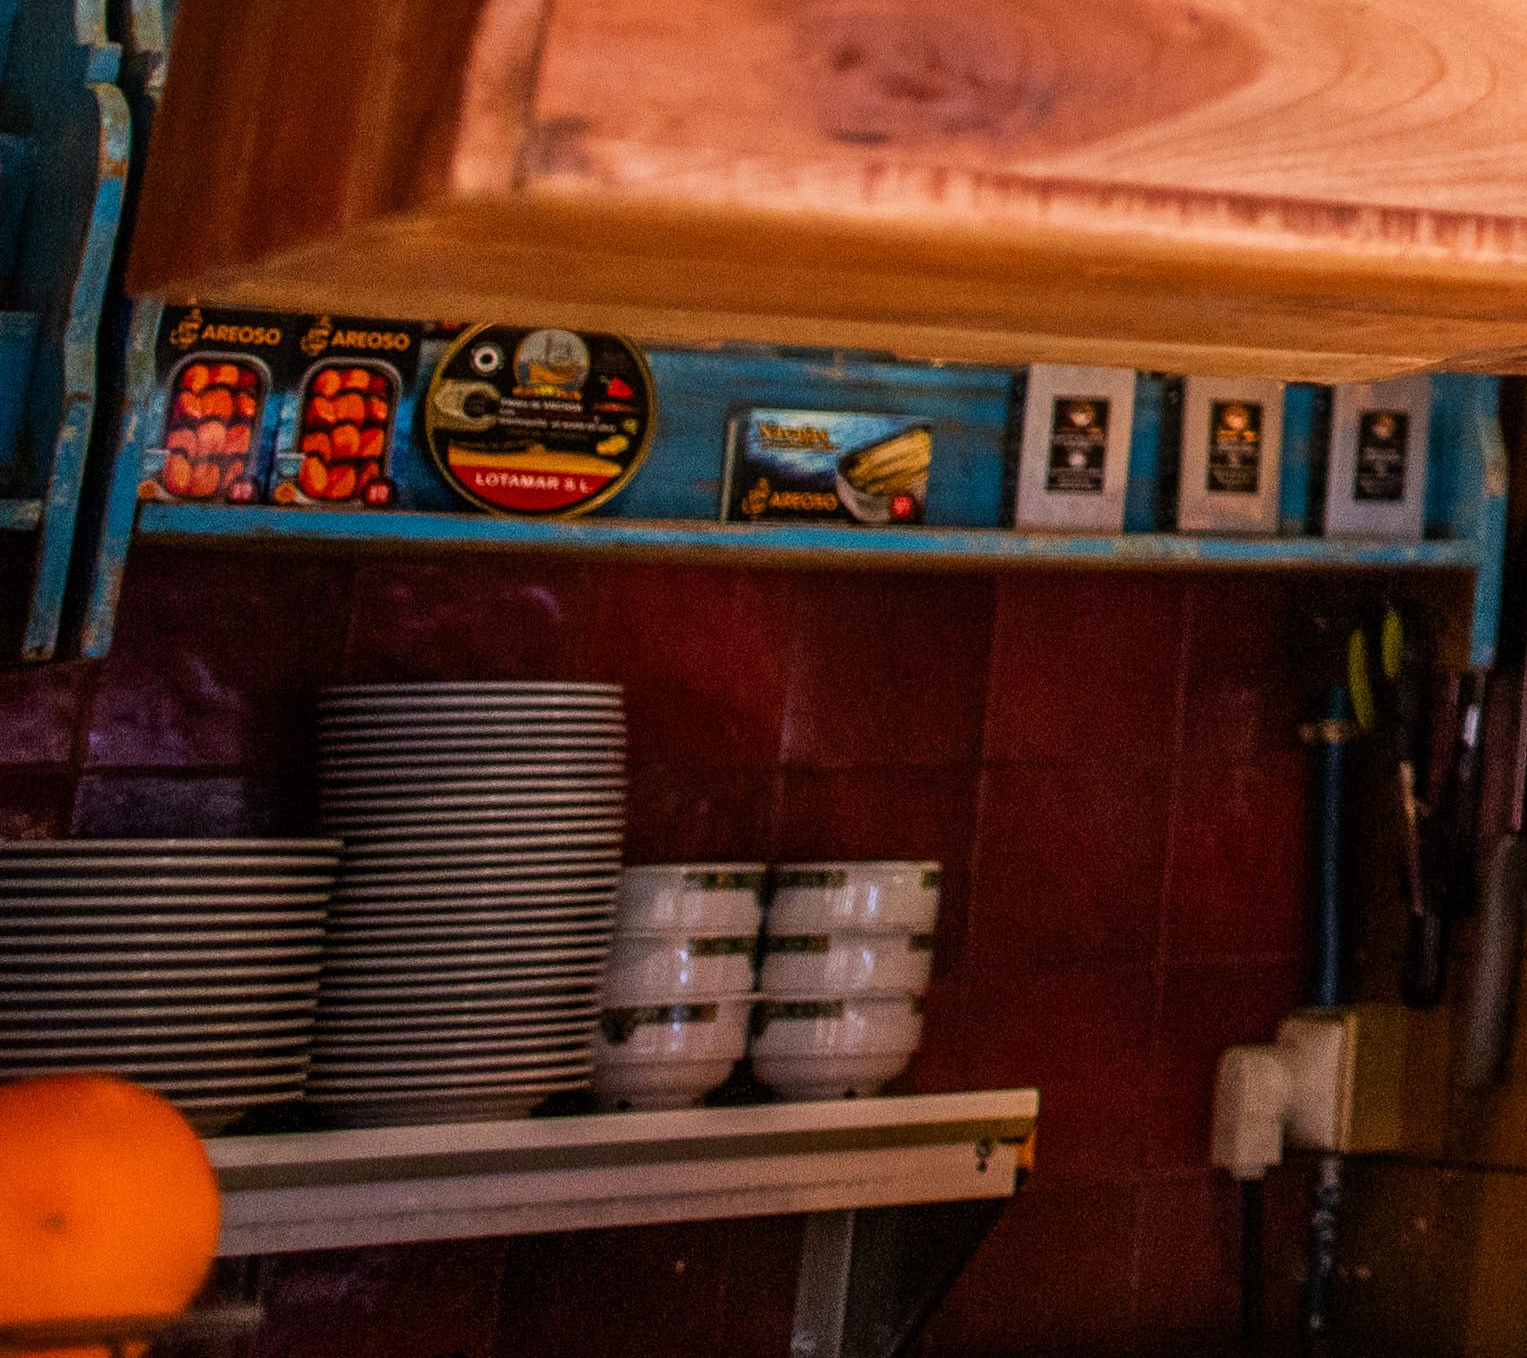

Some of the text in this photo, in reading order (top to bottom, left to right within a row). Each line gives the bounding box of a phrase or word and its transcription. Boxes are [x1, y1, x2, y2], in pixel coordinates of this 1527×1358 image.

[201, 324, 281, 346] AREOSO
[331, 329, 411, 352] AREOSO
[475, 471, 560, 492] LOTAMAR
